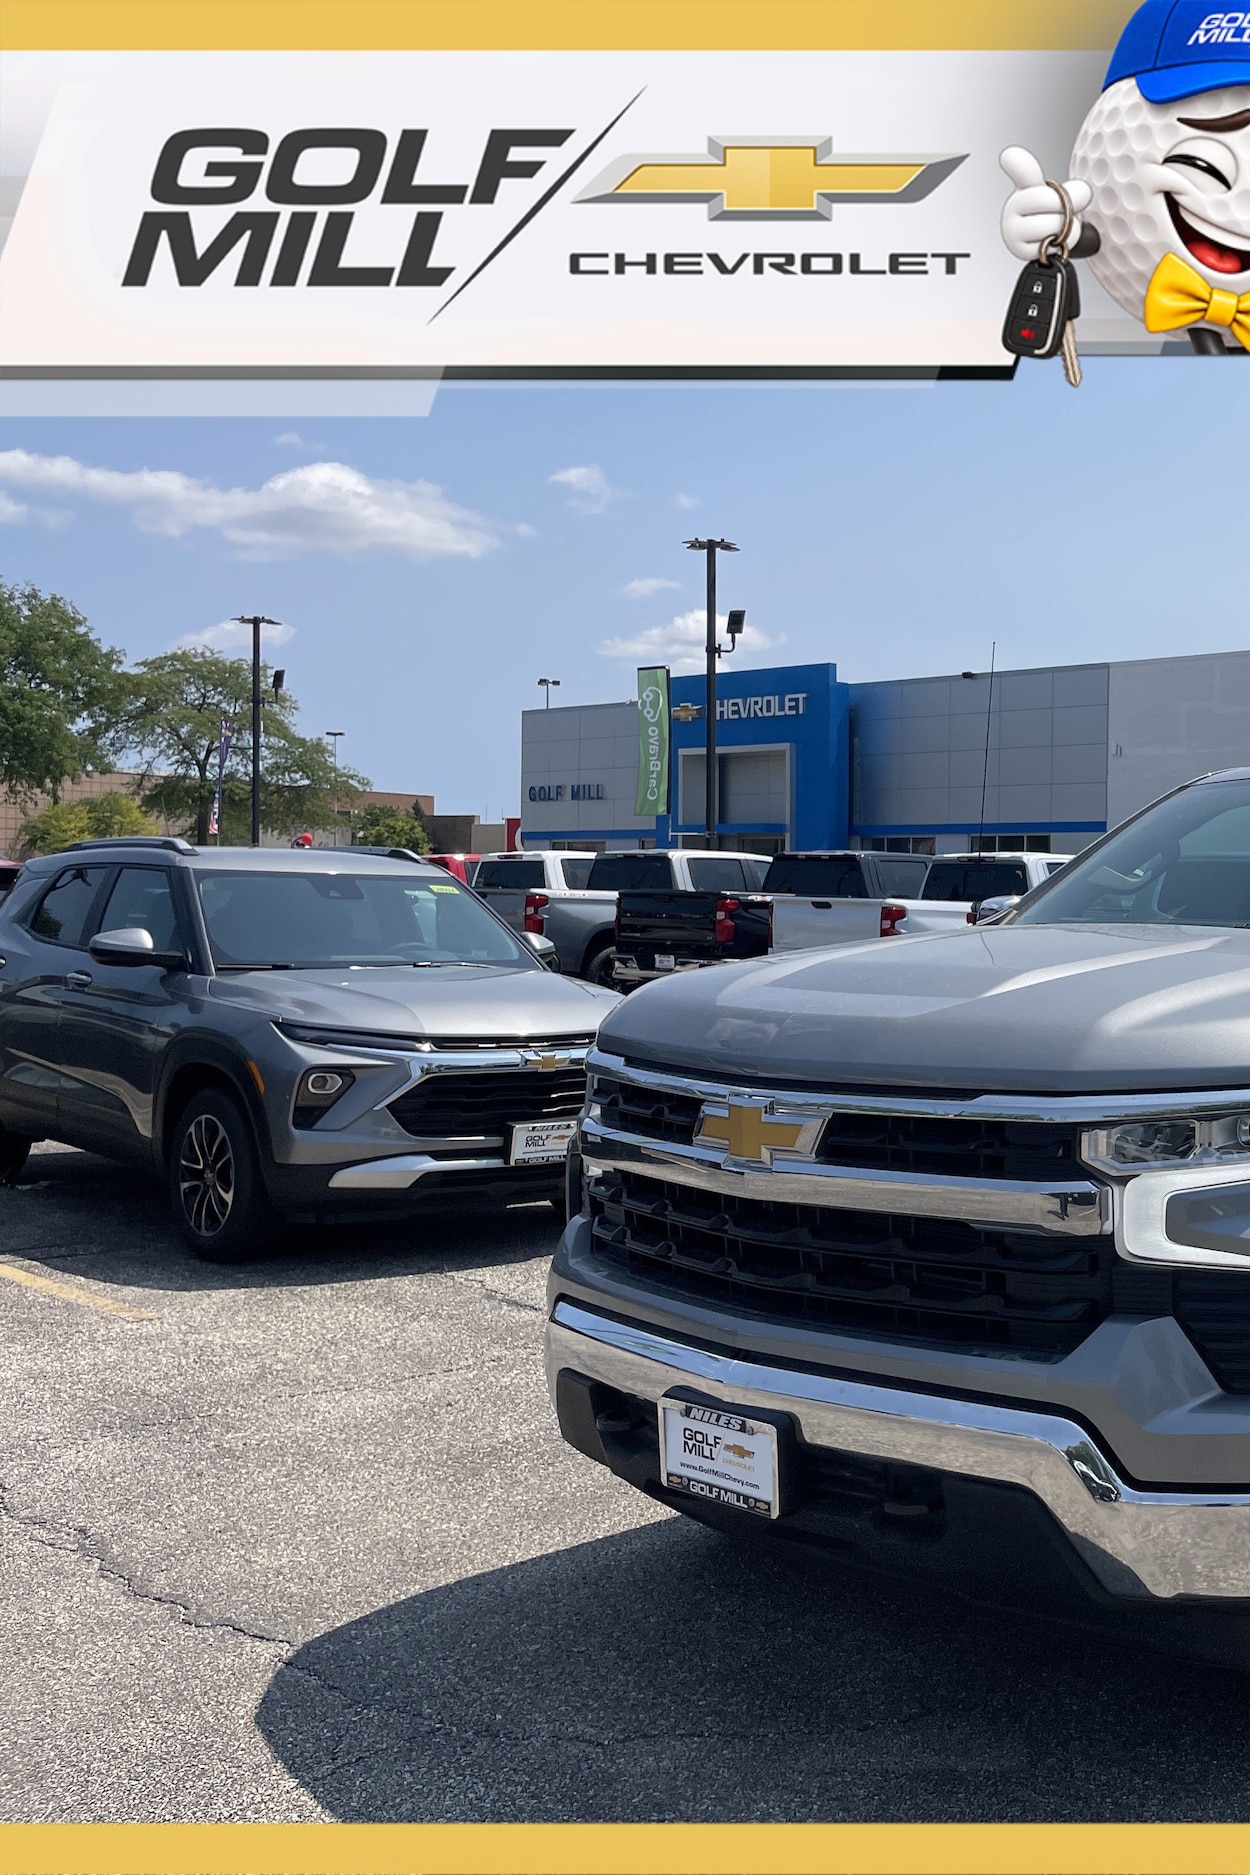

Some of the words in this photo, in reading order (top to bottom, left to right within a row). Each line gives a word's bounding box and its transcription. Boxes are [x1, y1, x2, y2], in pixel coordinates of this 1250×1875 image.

[715, 692, 807, 720] HEVROLET
[528, 785, 562, 801] GOLF
[570, 783, 603, 800] MILL
[690, 1408, 742, 1430] NILES
[683, 1427, 722, 1448] GOLF
[683, 1440, 715, 1461] MILL
[680, 1461, 760, 1490] www.GolfMillChevy.com
[689, 1481, 720, 1499] GOLF
[720, 1489, 748, 1508] MILL
